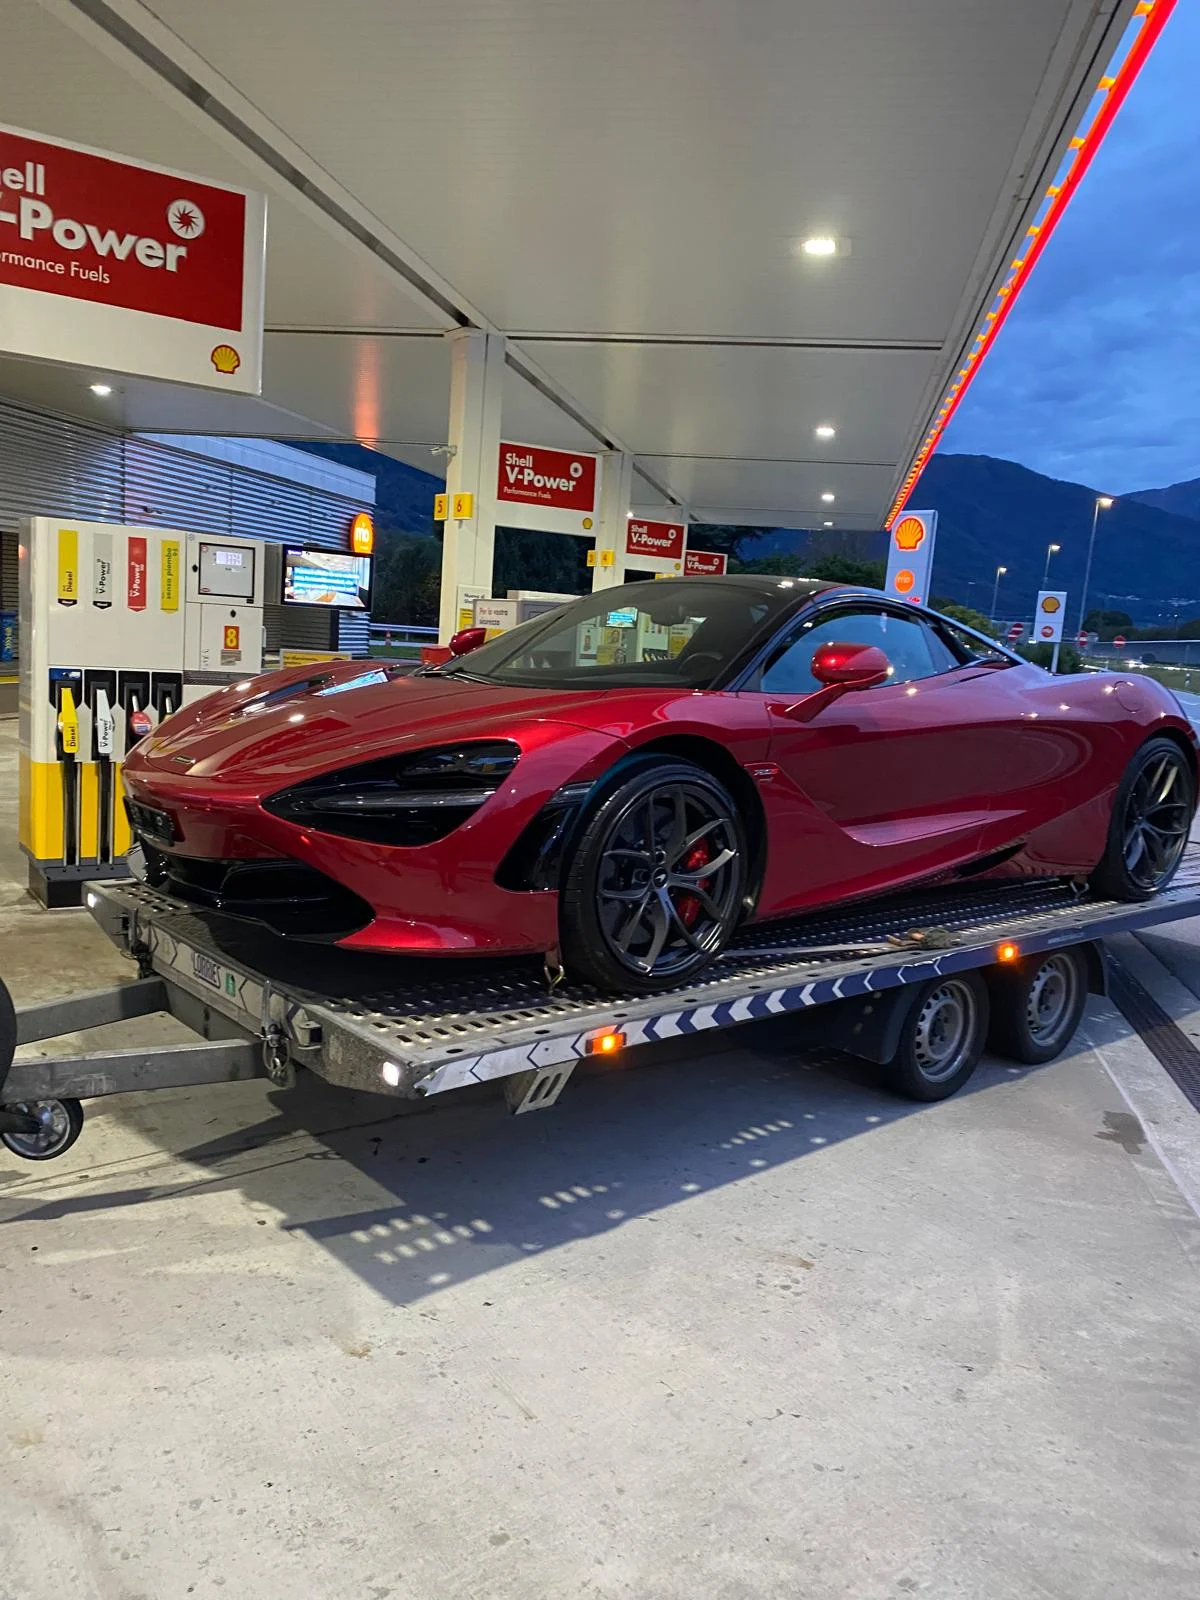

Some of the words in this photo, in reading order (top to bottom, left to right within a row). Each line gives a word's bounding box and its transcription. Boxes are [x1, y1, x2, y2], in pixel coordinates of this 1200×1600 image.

[0, 161, 46, 196] ell
[0, 189, 188, 273] -Power
[70, 261, 111, 284] Fuels
[505, 453, 533, 468] Shell
[505, 465, 577, 492] V-Power
[437, 499, 444, 513] 5
[456, 499, 463, 513] 6
[631, 524, 648, 534] Shell
[631, 532, 673, 548] V-Power
[96, 558, 106, 594] V-Power
[687, 560, 717, 571] V-Power
[131, 561, 141, 597] V-Power
[226, 627, 237, 648] 8
[100, 718, 109, 748] V-Power
